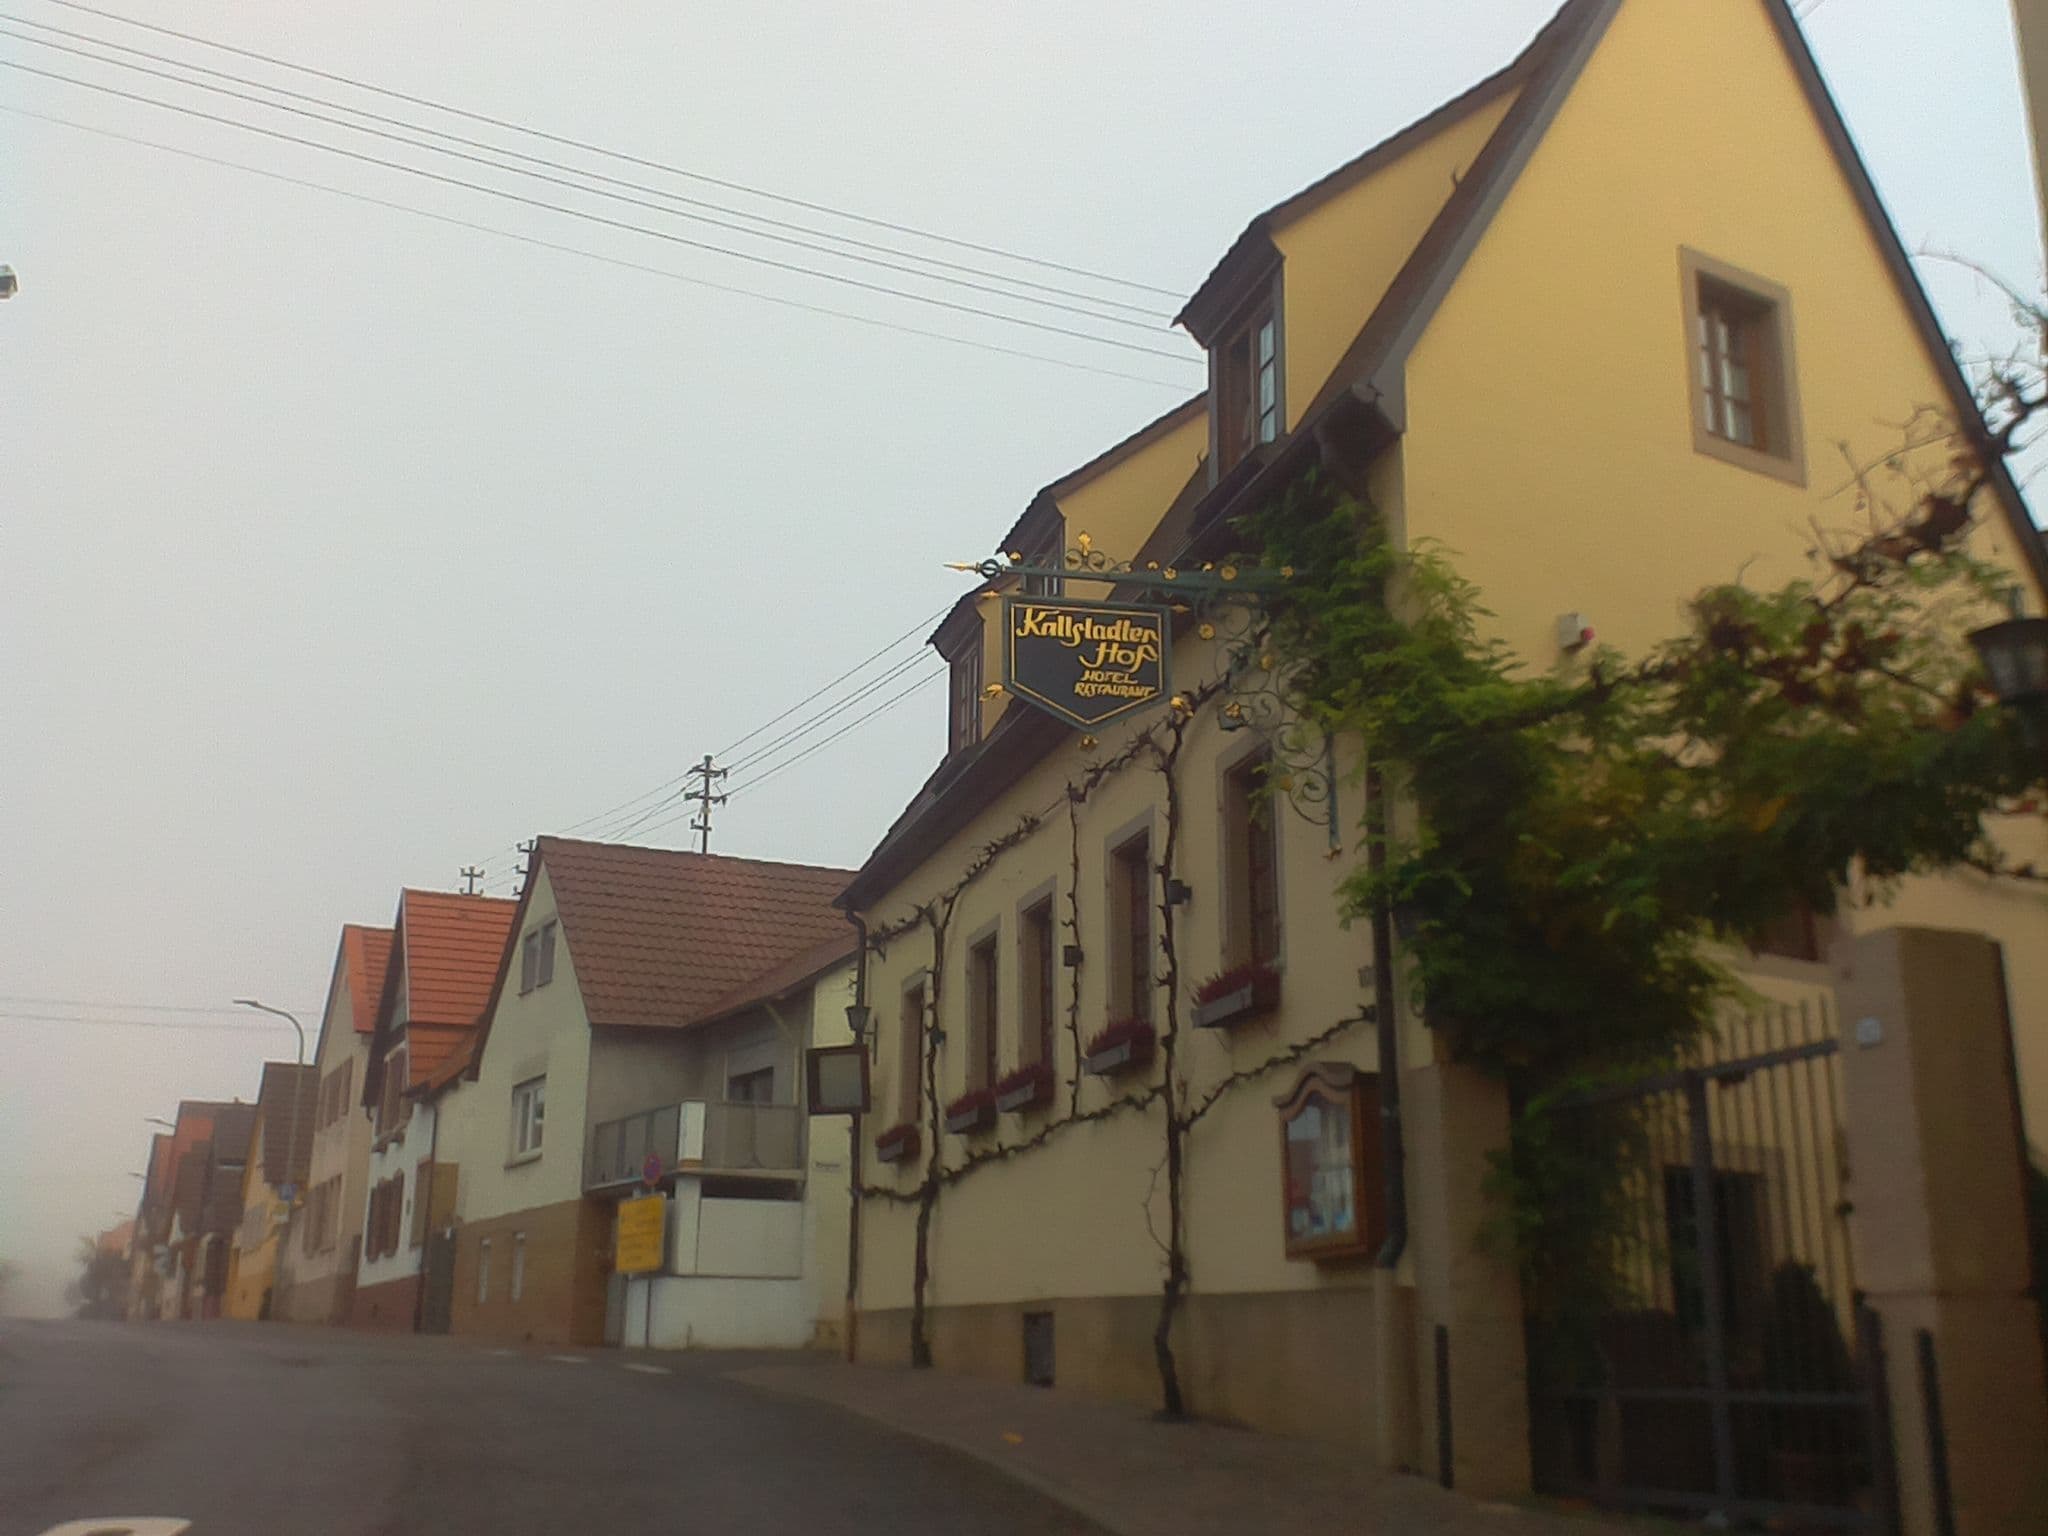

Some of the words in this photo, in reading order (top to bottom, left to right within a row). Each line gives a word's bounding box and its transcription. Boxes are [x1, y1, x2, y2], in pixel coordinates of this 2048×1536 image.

[1080, 643, 1158, 672] Hof
[1081, 671, 1138, 684] HOTEL
[1075, 683, 1156, 698] RESTAURANT
